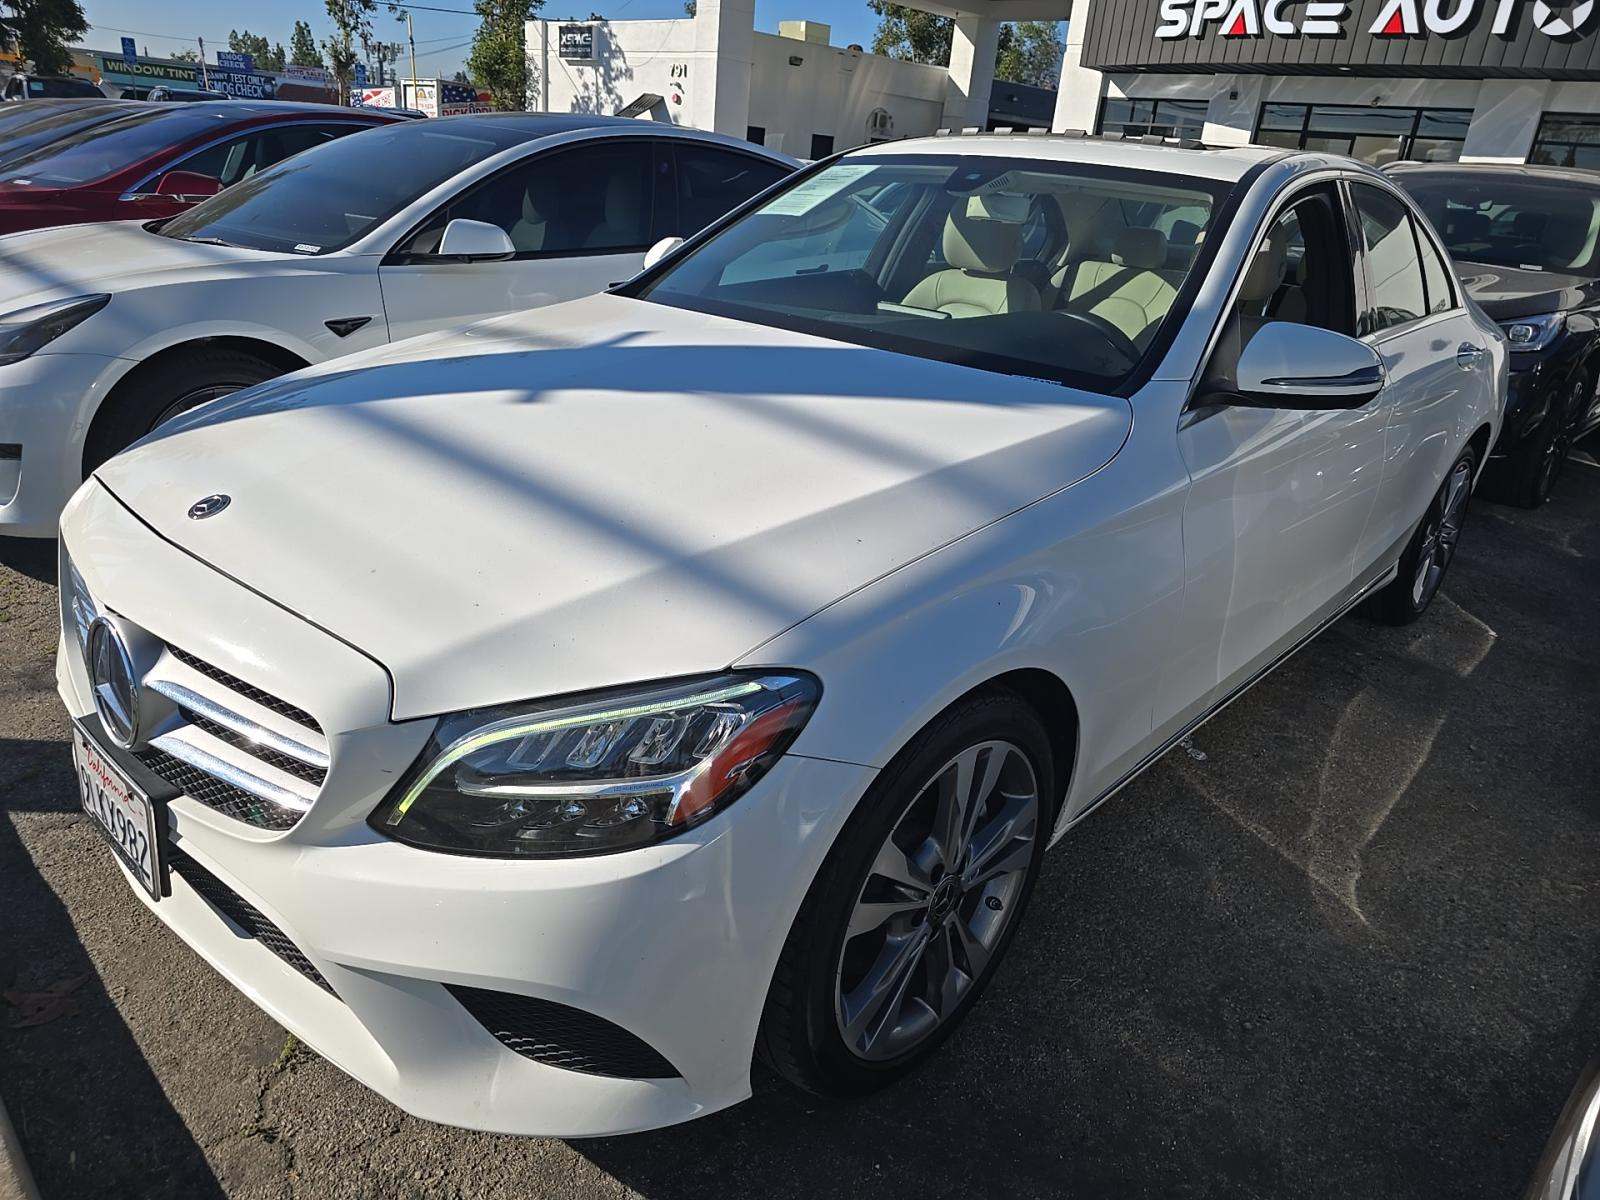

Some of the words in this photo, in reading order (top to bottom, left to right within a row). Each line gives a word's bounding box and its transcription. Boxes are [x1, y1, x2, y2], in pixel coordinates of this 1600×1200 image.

[1155, 0, 1345, 37] SPACE
[1368, 0, 1594, 36] AUTO
[221, 52, 243, 61] SMOG
[106, 61, 164, 76] WINDOW
[166, 68, 195, 80] TINT
[219, 60, 245, 69] CHECK
[229, 73, 247, 83] TEST
[247, 75, 265, 86] ONLY
[208, 80, 235, 95] SMOG
[235, 83, 264, 98] CHECK
